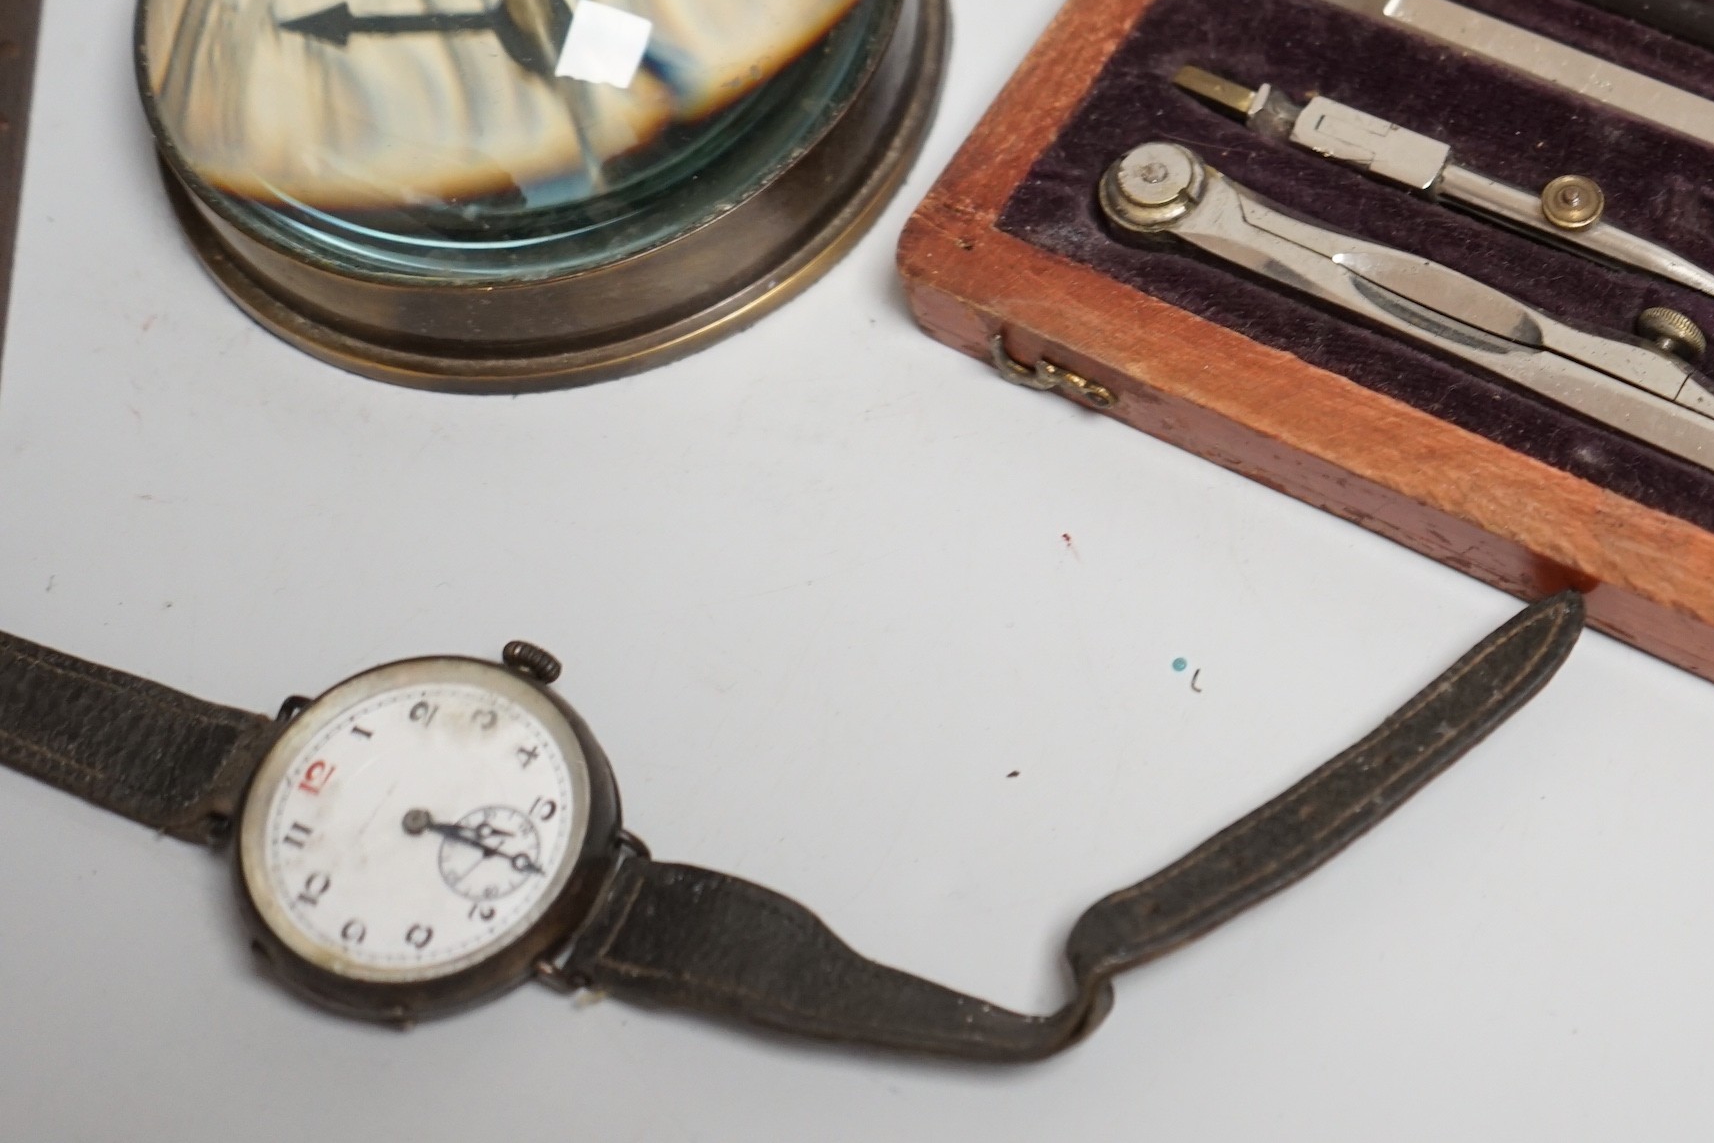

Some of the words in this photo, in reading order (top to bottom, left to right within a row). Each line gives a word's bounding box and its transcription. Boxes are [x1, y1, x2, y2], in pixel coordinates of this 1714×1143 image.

[409, 700, 439, 728] 2
[351, 725, 374, 740] 1
[516, 745, 540, 770] 4
[298, 760, 336, 796] 12
[529, 795, 557, 822] 5
[283, 821, 314, 849] 11
[297, 871, 332, 906] 10
